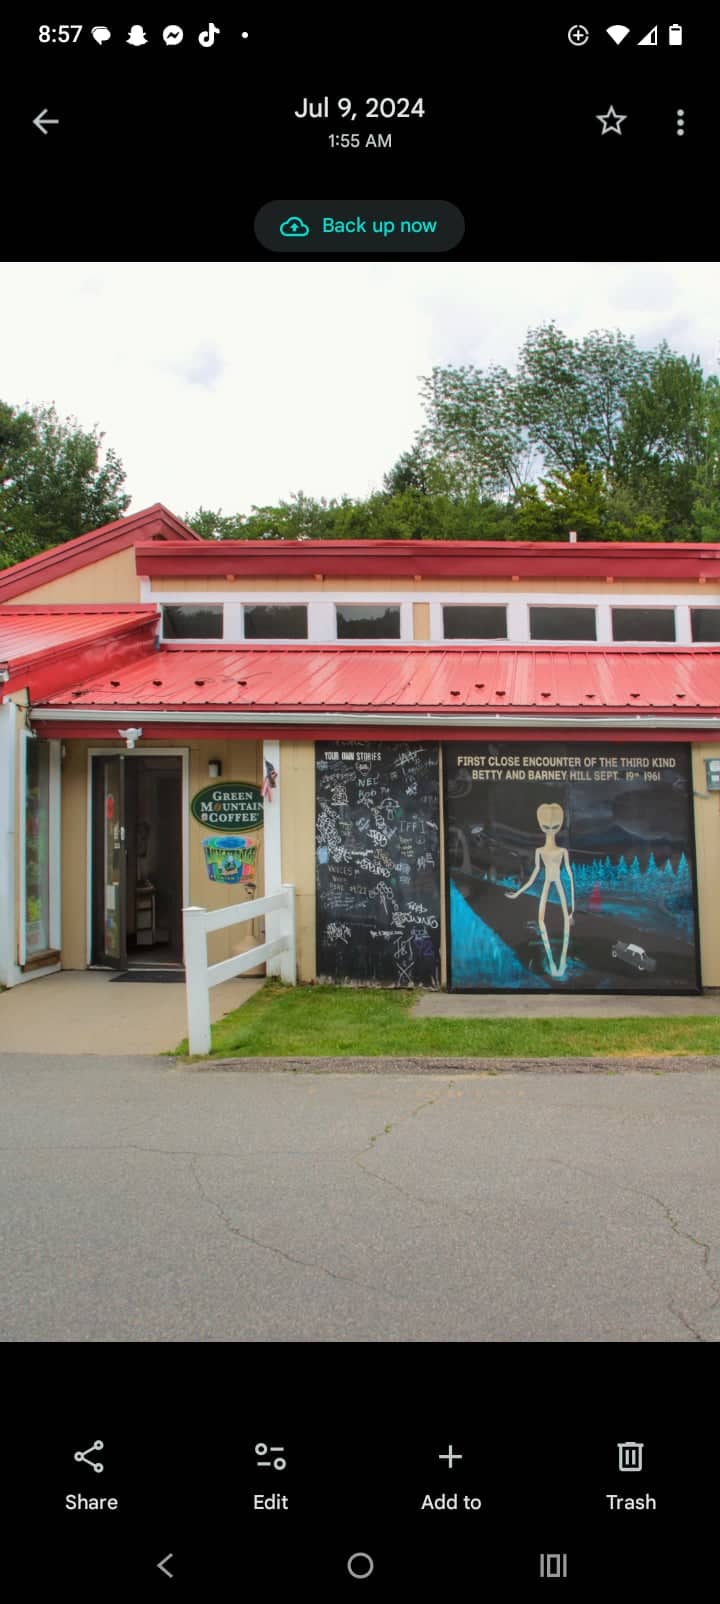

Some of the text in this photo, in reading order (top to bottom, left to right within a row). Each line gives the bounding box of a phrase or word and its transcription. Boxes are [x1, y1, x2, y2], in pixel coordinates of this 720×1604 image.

[324, 751, 382, 761] YOUR OWN STORIES
[457, 756, 676, 768] FIRST CLOSE ENCOUNTER OF THE THIRD KIND
[472, 769, 503, 780] BETTY
[505, 769, 526, 781] AND
[528, 769, 567, 781] BARNEY
[569, 770, 593, 781] HILL
[643, 771, 661, 781] 1961
[212, 791, 253, 801] GREEN
